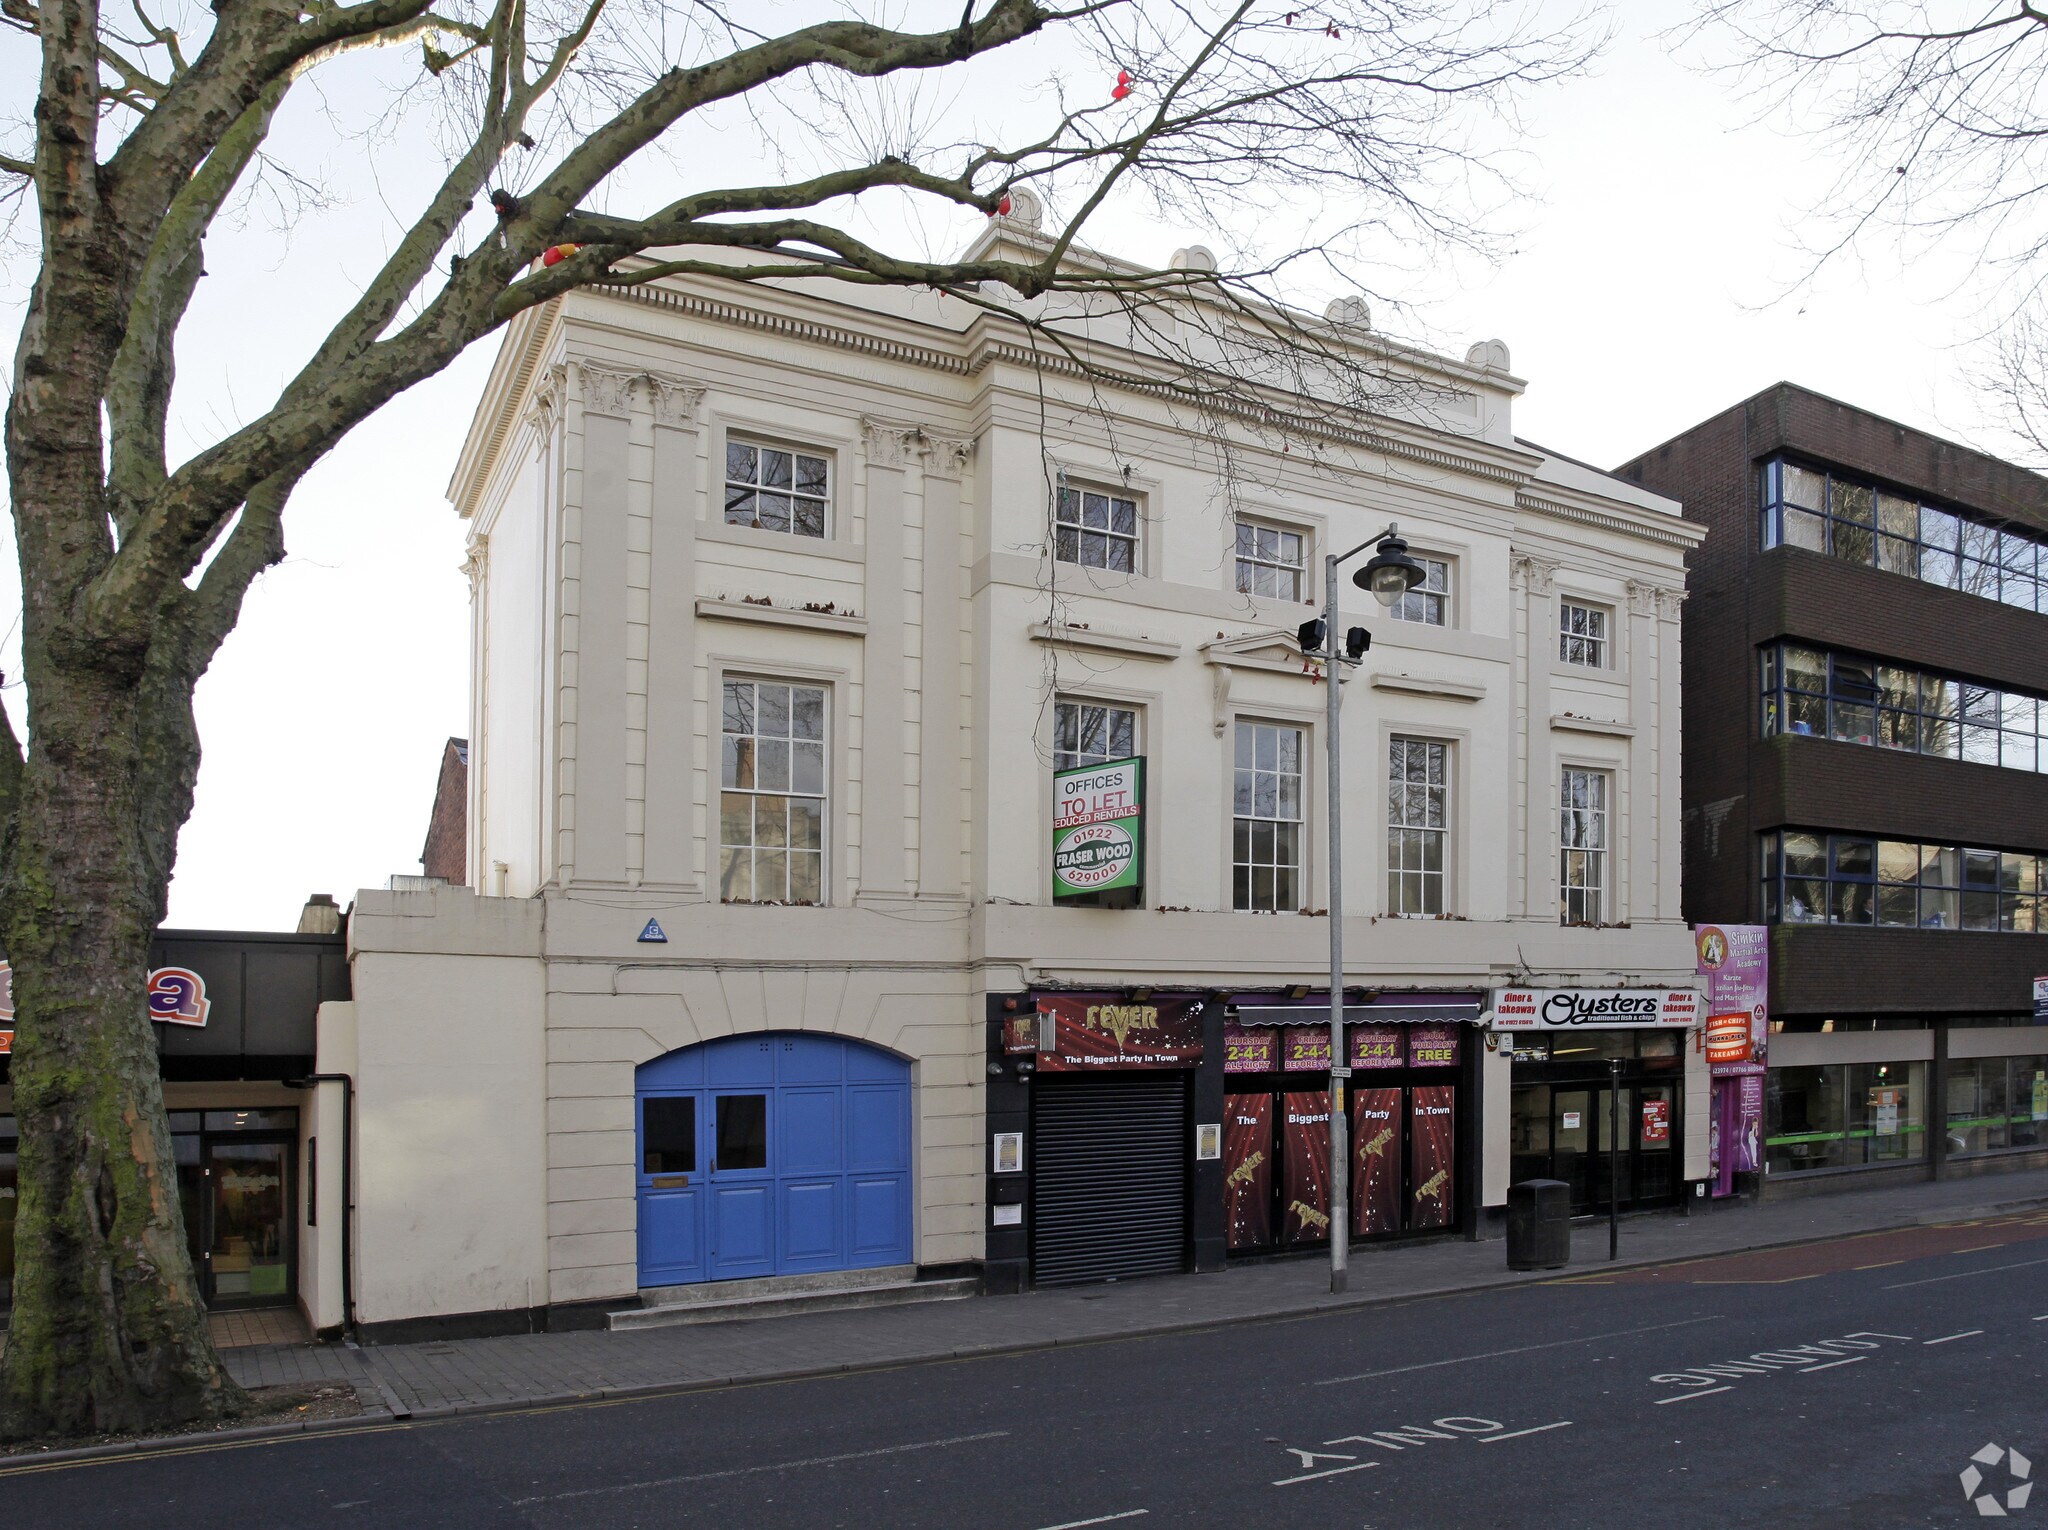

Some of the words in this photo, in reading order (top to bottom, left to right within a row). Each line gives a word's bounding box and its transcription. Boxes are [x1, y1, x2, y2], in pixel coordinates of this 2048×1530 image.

[1065, 772, 1123, 794] OFFICES
[1061, 797, 1086, 816] TO
[1092, 790, 1127, 812] LET
[1054, 813, 1091, 828] EDUCED
[1094, 805, 1137, 822] RENTALS
[1074, 828, 1112, 844] 01922
[1056, 850, 1093, 867] FRASER
[1096, 843, 1130, 860] WOOD
[1068, 864, 1117, 882] 629000
[1731, 931, 1764, 946] Simkin
[1730, 947, 1753, 958] Martial
[1754, 946, 1767, 955] Arts
[1736, 959, 1762, 969] Academy
[1504, 993, 1526, 1003] diner
[1527, 994, 1533, 1003] &
[1668, 993, 1687, 1001] diner
[1498, 1005, 1537, 1015] takeaway
[1542, 993, 1658, 1026] Oysters
[1663, 1003, 1696, 1013] takeaway
[1588, 1014, 1621, 1022] traditional
[1638, 1014, 1655, 1022] chips
[1709, 1019, 1723, 1028] FISH
[1087, 1005, 1160, 1049] FEVER
[1224, 1036, 1271, 1046] THURSDAY
[1297, 1035, 1329, 1044] FRIDAY
[1357, 1034, 1398, 1043] SATURDAY
[1423, 1031, 1446, 1040] BOOK
[1359, 1043, 1396, 1057] 2-4-1
[1411, 1041, 1432, 1050] YOUR
[1433, 1040, 1457, 1049] PARTY
[1227, 1045, 1268, 1060] 2-4-1
[1293, 1044, 1331, 1059] 2-4-1
[1417, 1049, 1452, 1060] FREE
[1710, 1048, 1744, 1058] TAKEAWAY
[1065, 1055, 1082, 1063] The
[1084, 1055, 1118, 1065] Biggest
[1119, 1054, 1143, 1064] Party
[1144, 1054, 1153, 1063] In
[1155, 1054, 1178, 1062] Town
[1224, 1061, 1242, 1070] ALL
[1243, 1060, 1271, 1070] NIGHT
[1284, 1060, 1317, 1069] BEFORE
[1351, 1058, 1382, 1067] BEFORE
[1365, 1110, 1390, 1120] Party
[1415, 1107, 1424, 1116] In
[1426, 1106, 1450, 1115] Town
[1237, 1116, 1257, 1125] The
[1288, 1113, 1329, 1125] Biggest
[1360, 1127, 1395, 1161] FEVER
[1227, 1151, 1265, 1189] FEVER
[1415, 1169, 1449, 1202] FEVER
[1288, 1200, 1330, 1229] FEVER
[1650, 1332, 1912, 1386] LOADING
[1286, 1416, 1504, 1467] ONLY
